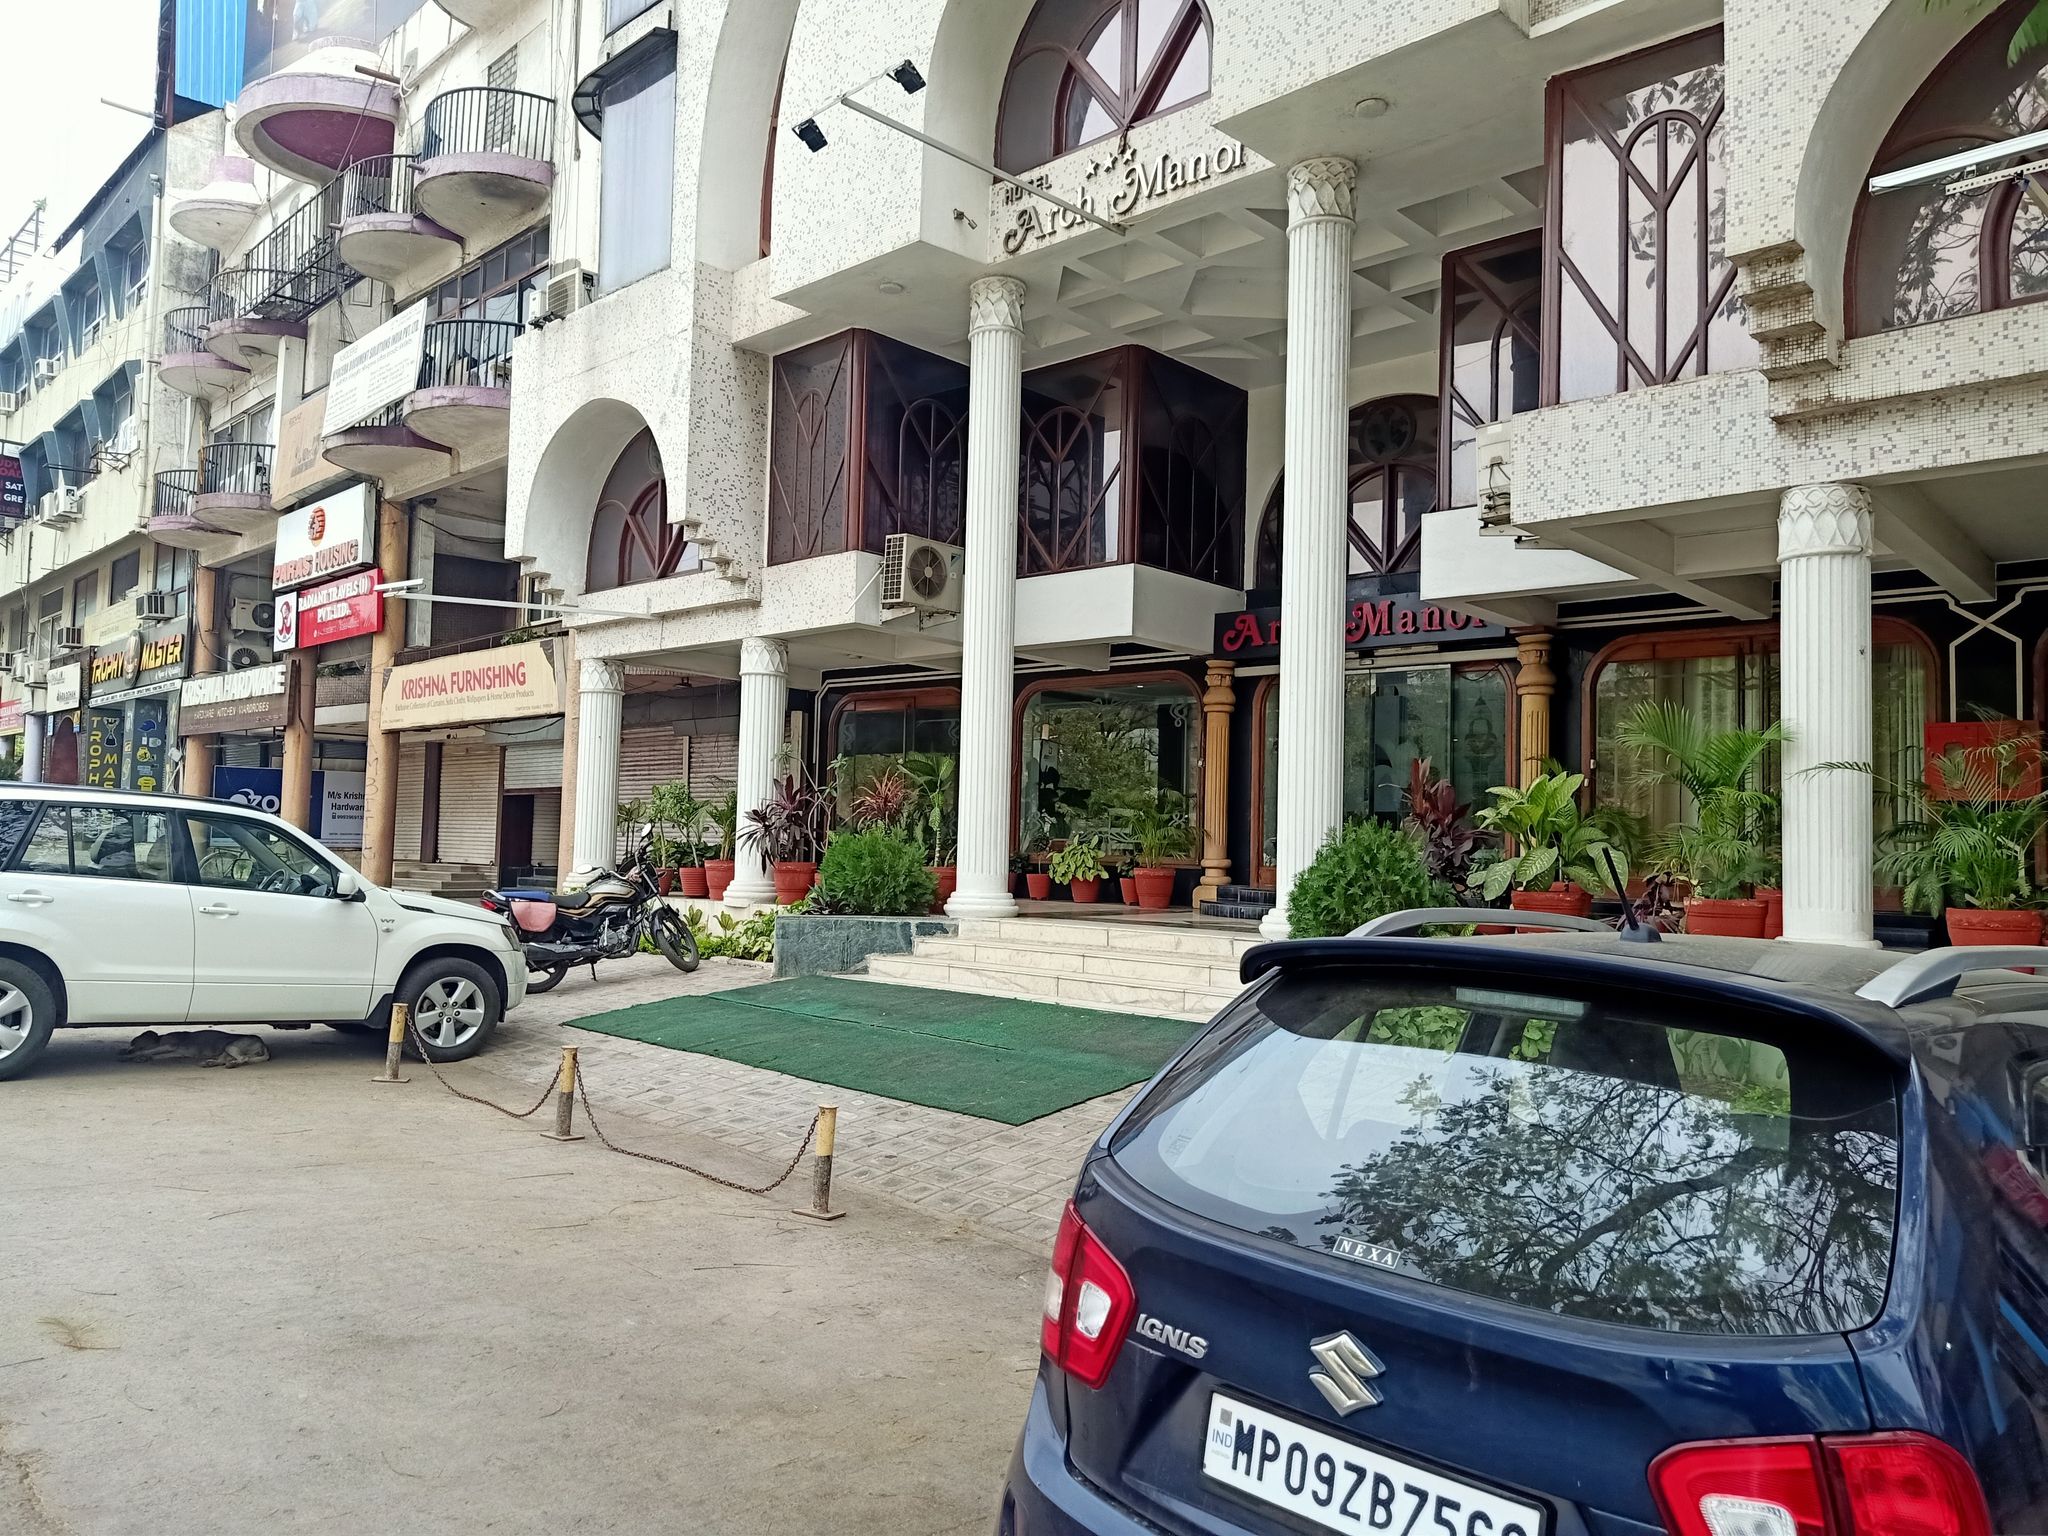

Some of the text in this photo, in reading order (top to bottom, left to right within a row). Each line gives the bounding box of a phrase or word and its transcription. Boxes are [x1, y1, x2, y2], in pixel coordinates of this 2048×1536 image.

[1003, 186, 1095, 254] Arch
[3, 493, 24, 504] GRE
[5, 481, 24, 491] SAT
[274, 539, 358, 585] PARAS HOUSING
[328, 579, 359, 603] TRAVELS
[1222, 613, 1280, 653] Ar
[92, 652, 124, 684] TROPHY
[140, 634, 184, 671] MASTER
[224, 664, 286, 701] HARDWARE
[401, 661, 526, 700] KRISHNA FURNISHING
[491, 692, 502, 700] Home
[88, 716, 102, 784] TROPH
[328, 791, 365, 800] M/s Krish
[331, 802, 365, 811] Hardwar
[1339, 1240, 1393, 1266] NEXA
[1136, 1313, 1207, 1359] IGNIS
[1212, 1429, 1232, 1448] IND
[1232, 1418, 1527, 1536] MP09ZB756
